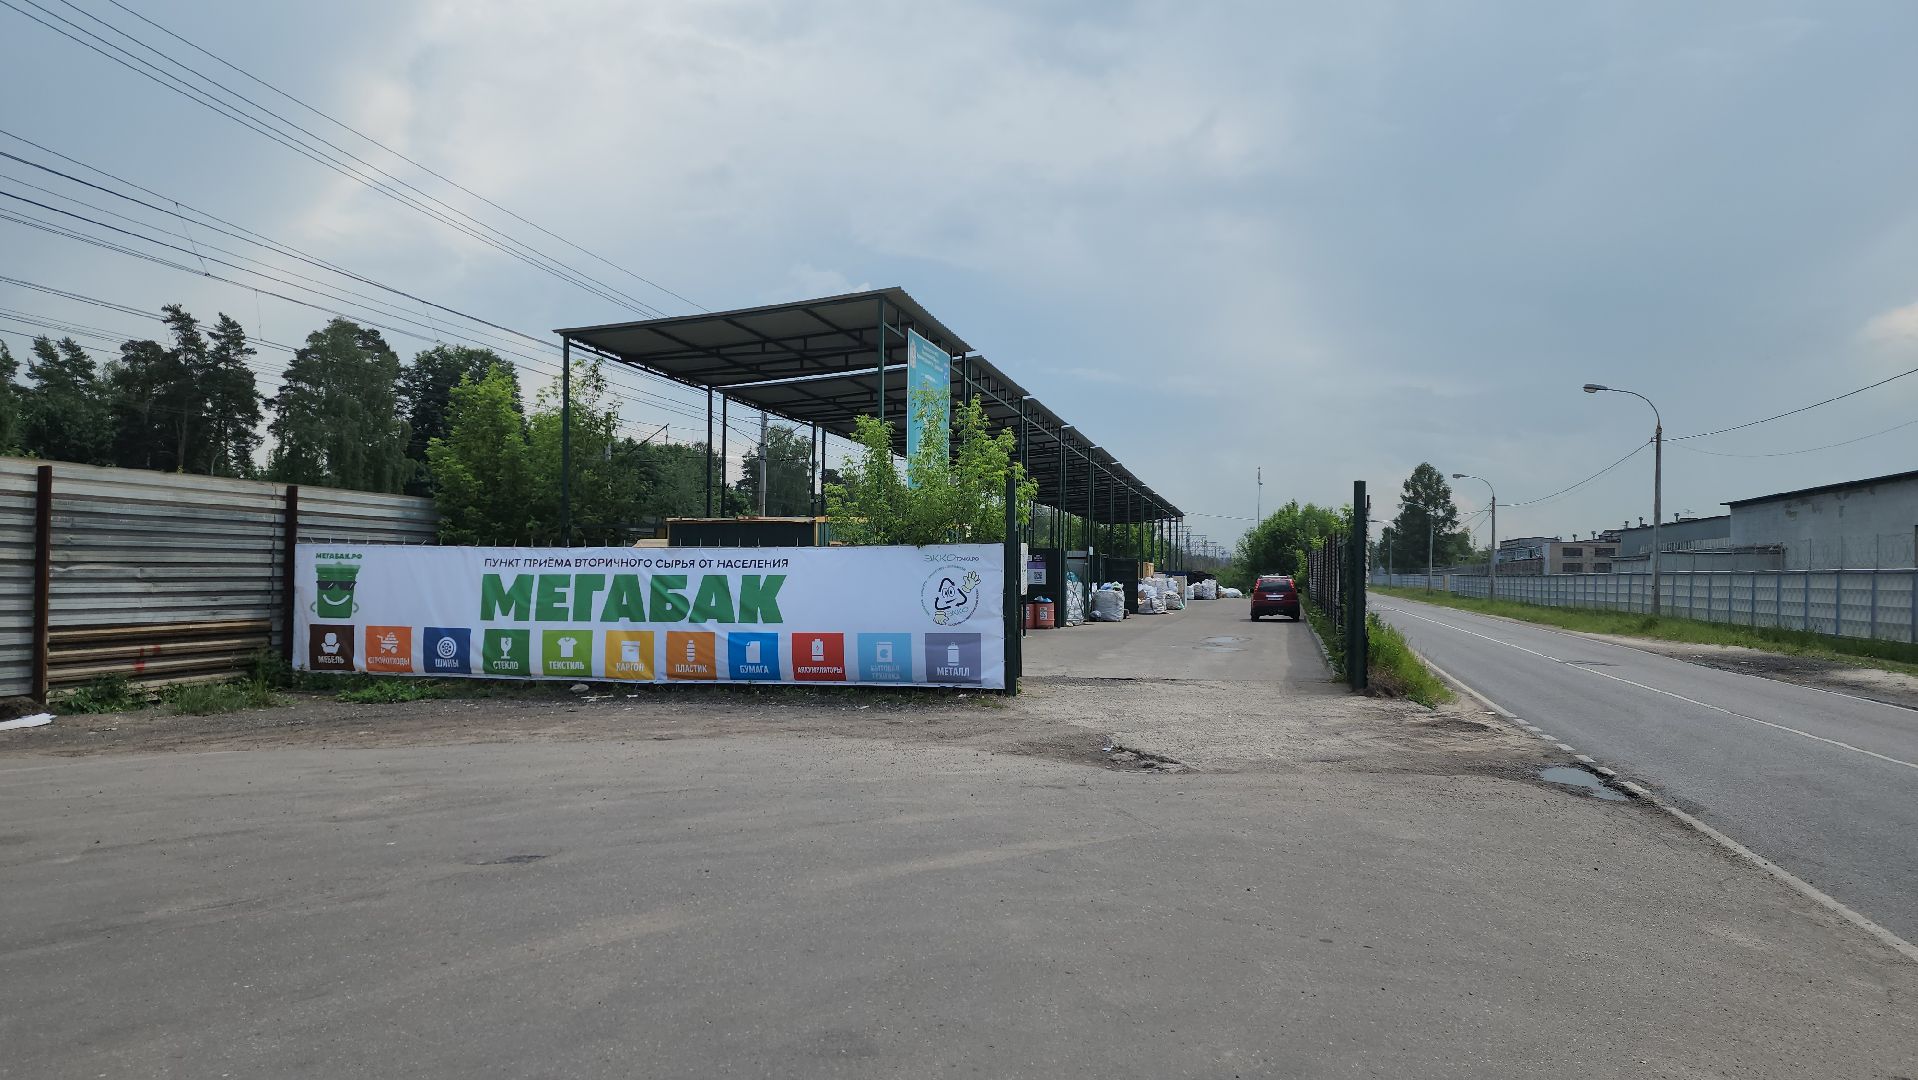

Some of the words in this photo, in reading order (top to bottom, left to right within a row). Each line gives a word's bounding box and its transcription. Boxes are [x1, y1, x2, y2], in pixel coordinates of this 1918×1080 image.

[315, 552, 363, 560] МЕГАБАК.РФ
[484, 558, 521, 568] ПУНКТ
[523, 557, 571, 568] ПРИЁМА
[574, 558, 652, 568] ВТОРИЧНОГО
[655, 559, 695, 569] СЫРЬЯ
[698, 559, 713, 569] ОТ
[716, 558, 789, 569] НАСЕЛЕНИЯ
[480, 573, 787, 623] МЕГАБАК
[317, 655, 345, 664] МЕБЕЛЬ
[434, 658, 459, 667] ШИНЫ
[493, 660, 519, 669] СТЕКЛО
[549, 660, 585, 670] ТЕКСТИЛЬ
[616, 662, 645, 672] КАРТОН
[675, 664, 708, 673] ПЛАСТИК
[739, 665, 769, 674] БУМАГА
[936, 667, 970, 677] МЕТАЛЛ
